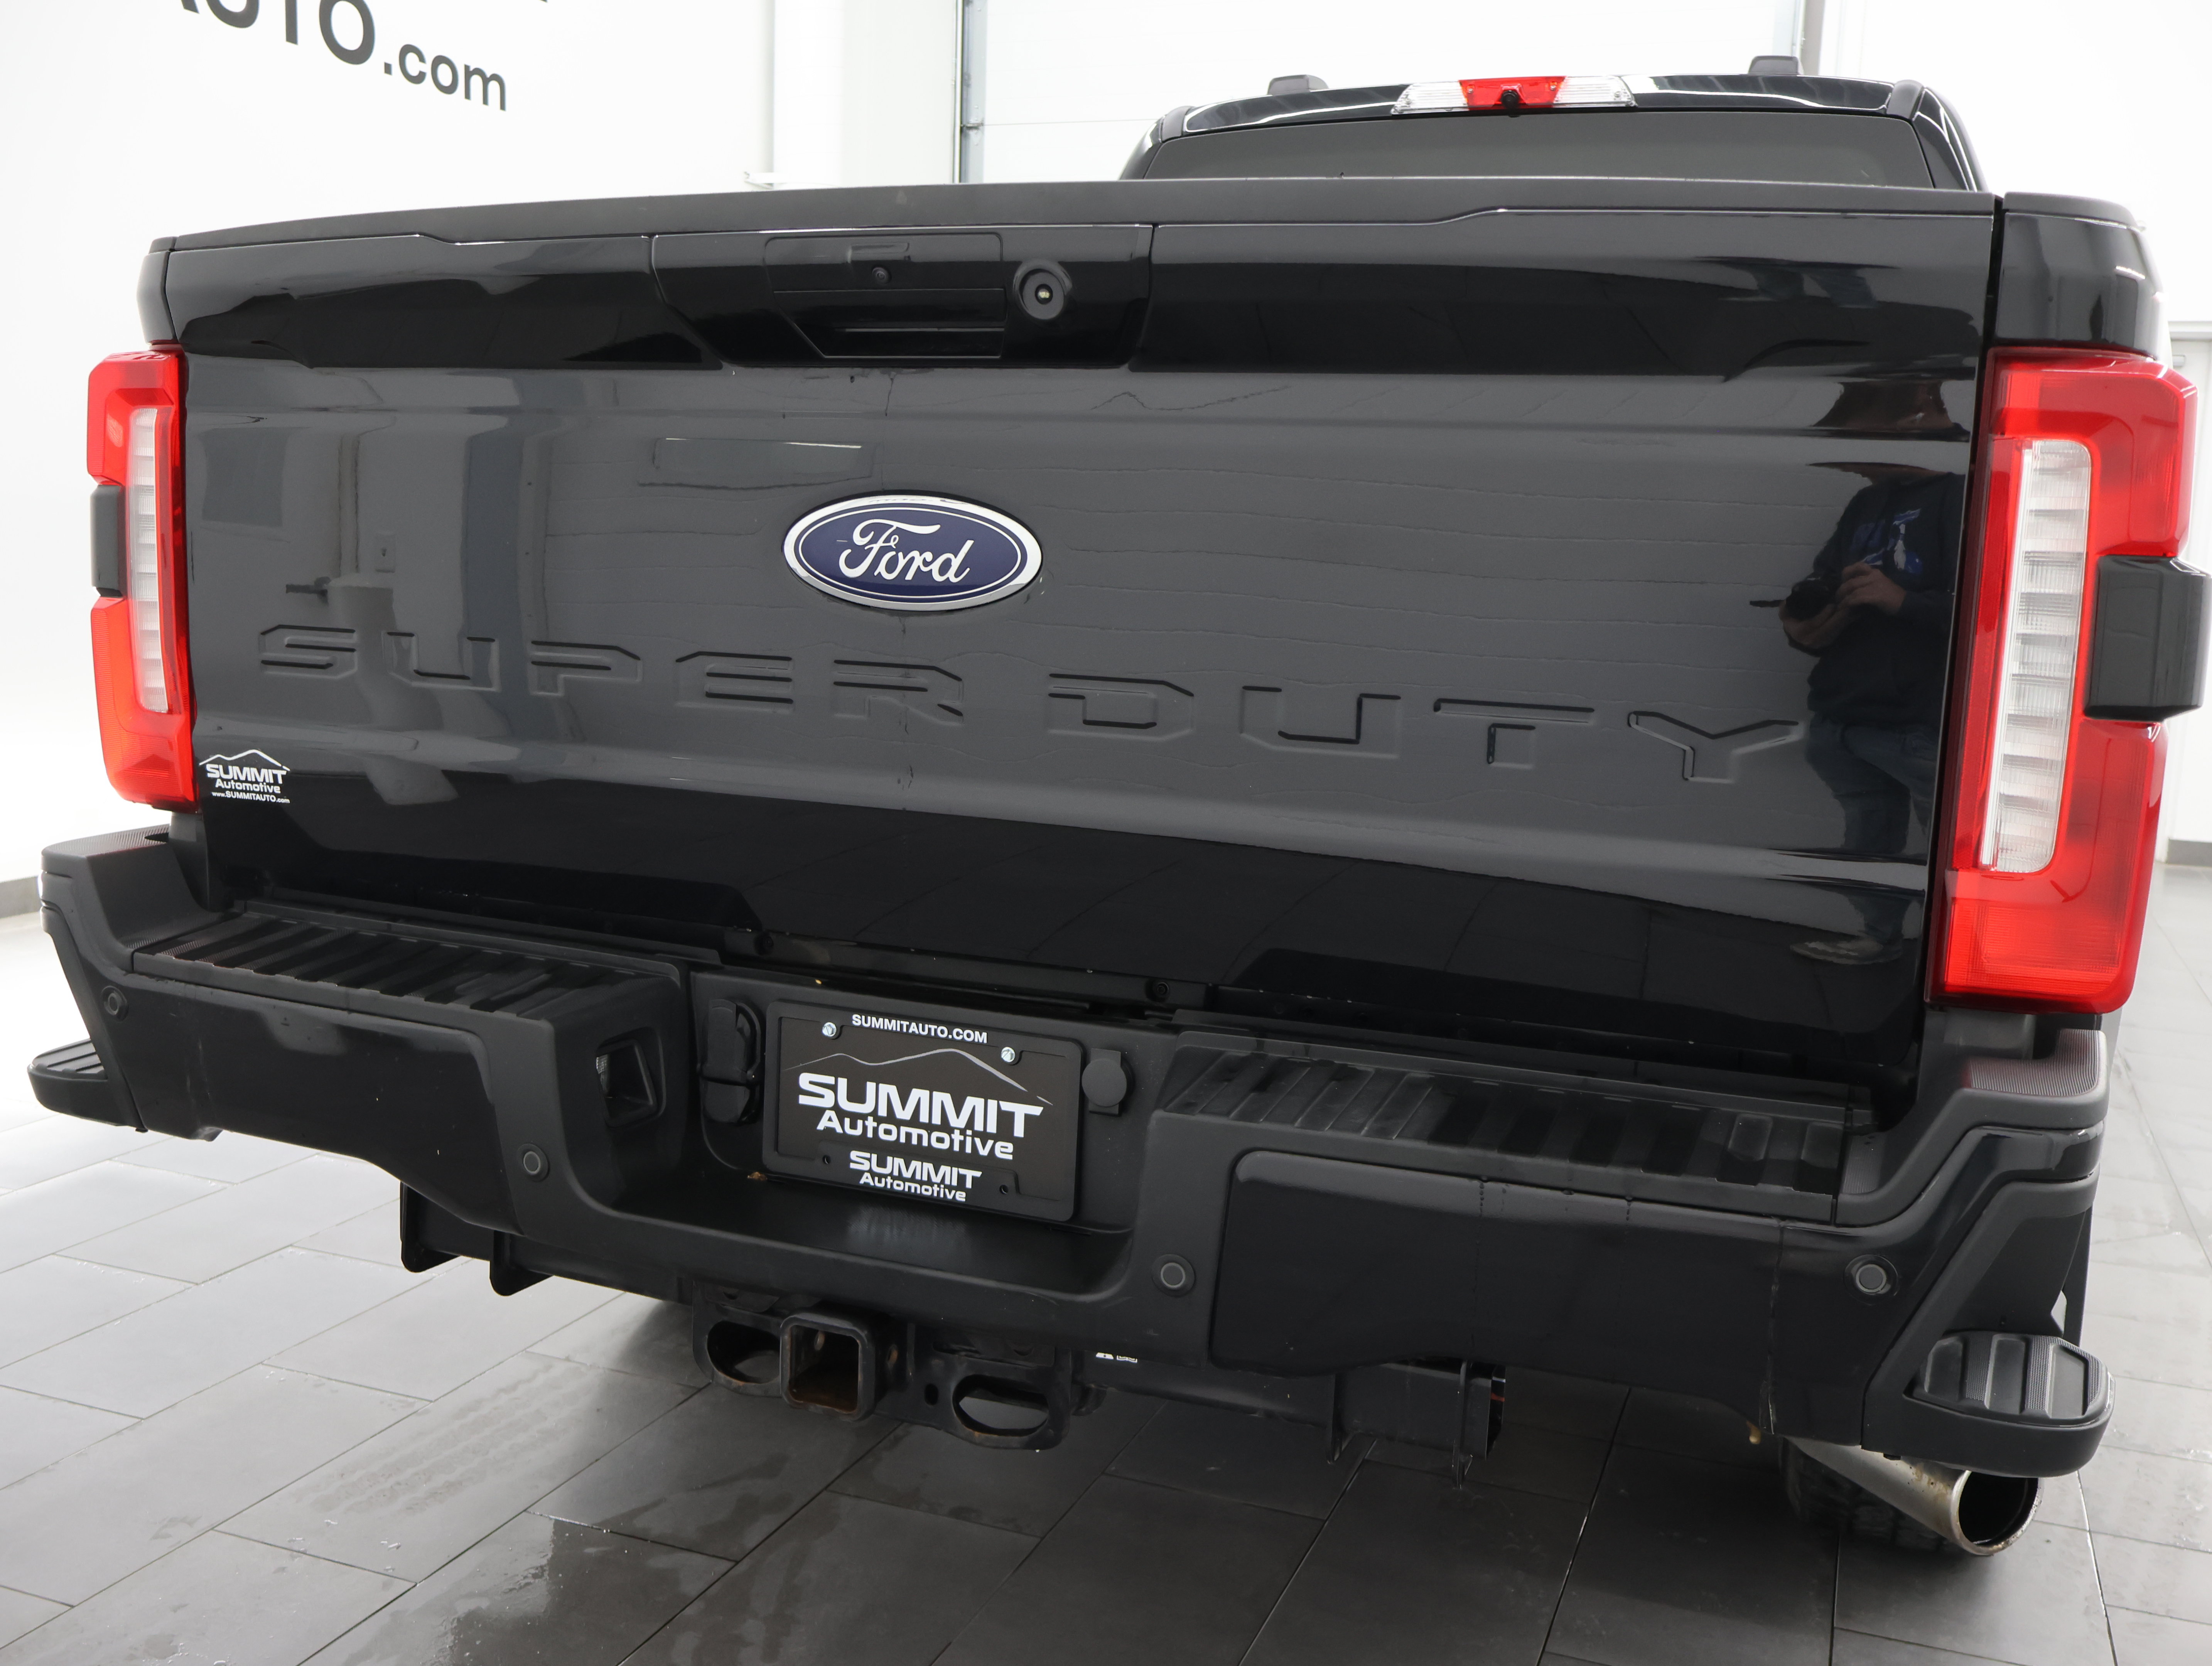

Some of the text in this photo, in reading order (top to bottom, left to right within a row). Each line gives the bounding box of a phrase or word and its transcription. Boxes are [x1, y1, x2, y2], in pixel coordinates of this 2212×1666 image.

[181, 0, 506, 111] TO.com
[839, 519, 974, 582] Ford
[259, 624, 1807, 784] SUPER DUTY
[206, 764, 287, 784] SUMMIT
[215, 779, 281, 793] Automotive
[211, 791, 290, 803] www.SUMMITAUTO.com
[852, 1014, 987, 1044] SUMMITAUTO.COM
[798, 1072, 1043, 1138] SUMMIT
[817, 1110, 1014, 1160] Automotive
[849, 1151, 982, 1189] SUMMIT
[859, 1172, 966, 1202] Automotive
